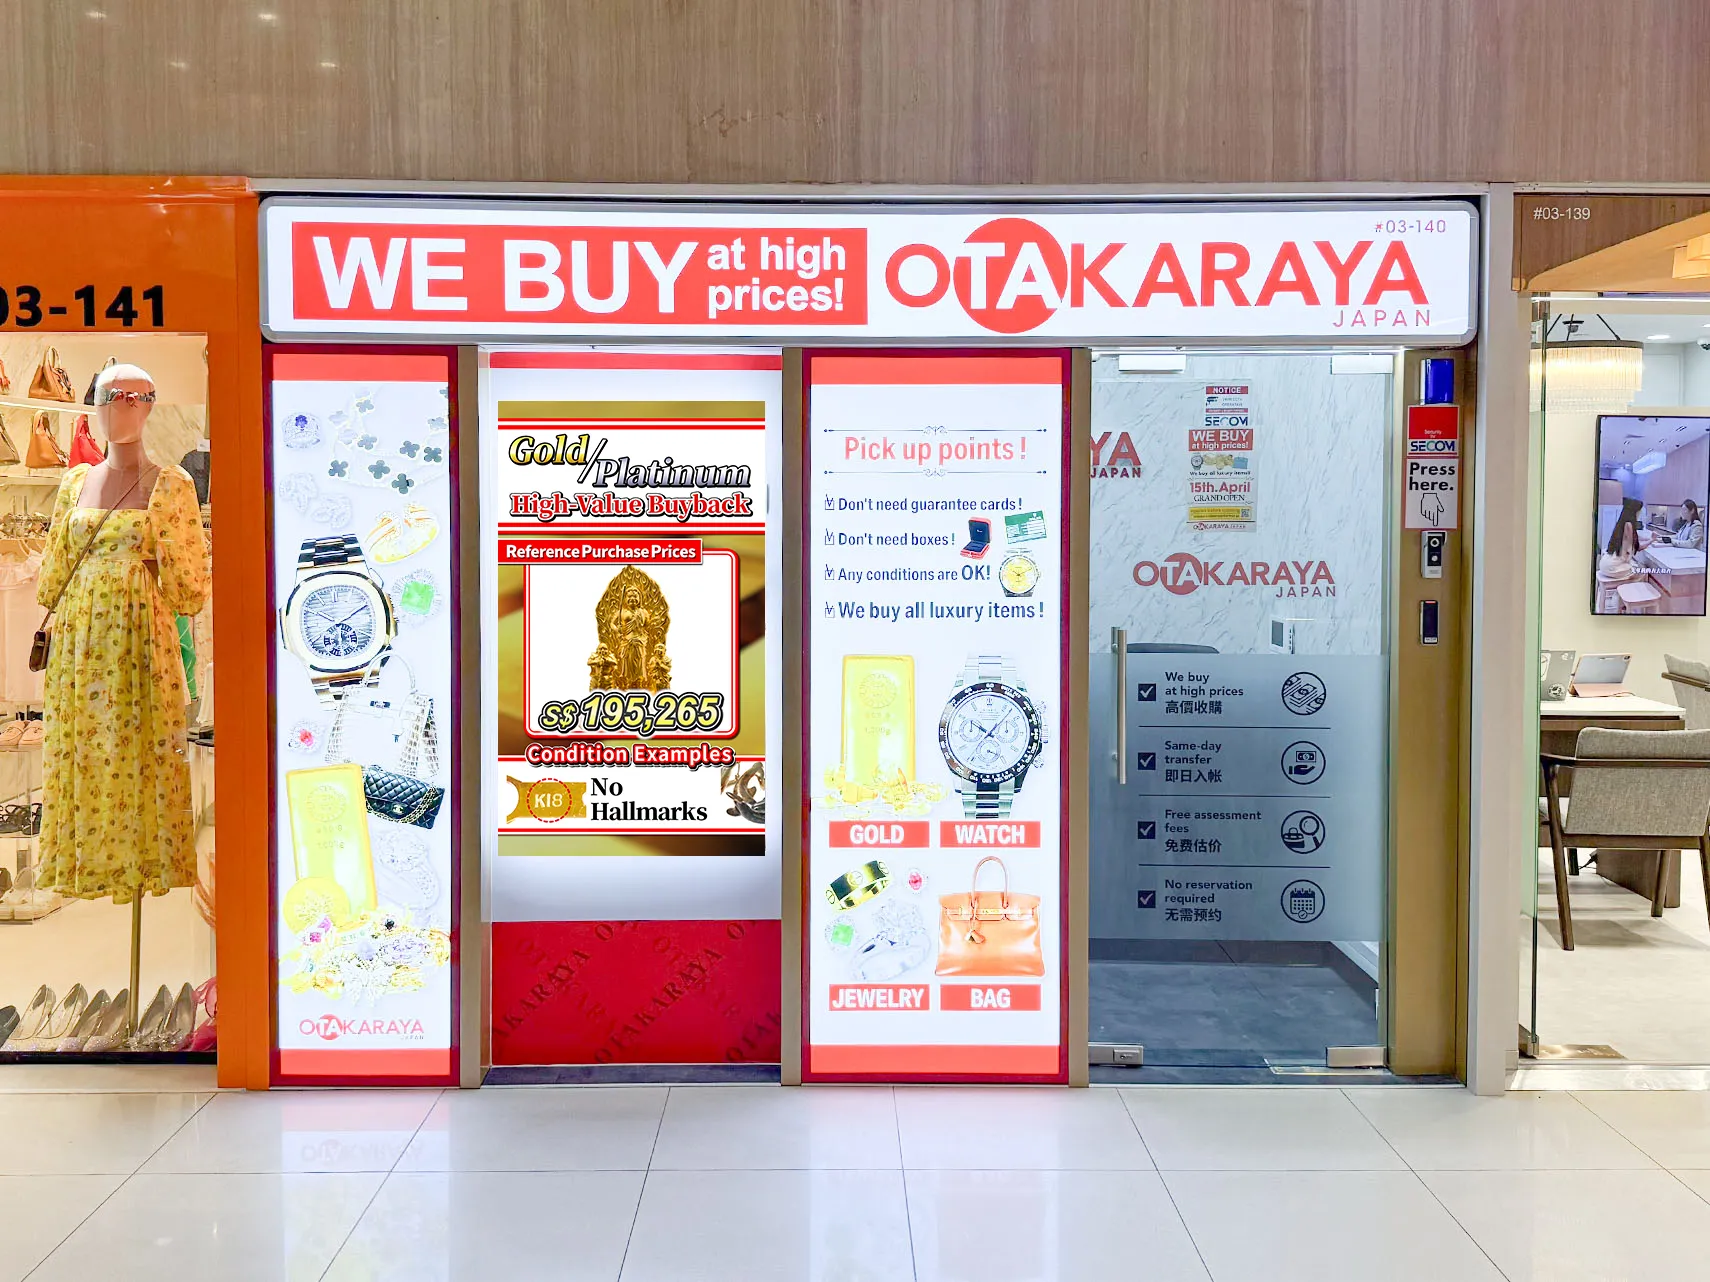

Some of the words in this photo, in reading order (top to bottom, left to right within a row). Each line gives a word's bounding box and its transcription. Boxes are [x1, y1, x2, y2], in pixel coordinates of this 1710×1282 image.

[1533, 206, 1591, 220] #03-139
[1375, 219, 1446, 233] #03-140
[707, 237, 746, 270] at
[759, 237, 846, 279] high
[313, 236, 468, 311] WE
[504, 240, 698, 314] BUY
[885, 238, 1430, 311] OTAKARAYA
[707, 278, 844, 319] prices!
[1333, 309, 1431, 327] JAPAN
[1205, 416, 1248, 426] SECOM
[1192, 431, 1215, 441] WE
[1219, 430, 1249, 441] BUY
[845, 437, 895, 459] Pick
[903, 443, 932, 465] up
[1411, 441, 1455, 451] SECOM
[593, 457, 752, 488] Platinum
[1090, 467, 1141, 478] JAPAN
[1409, 462, 1456, 475] Press
[1409, 476, 1454, 490] here.
[509, 492, 642, 521] High-Value
[645, 492, 751, 521] Buyback
[838, 498, 874, 511] Don't
[876, 498, 908, 511] need
[911, 500, 977, 513] guarantee
[838, 533, 874, 545] Don't
[876, 533, 908, 545] need
[506, 544, 581, 559] Reference
[582, 544, 650, 559] Purchase
[651, 544, 697, 559] Prices
[838, 568, 862, 583] Any
[866, 568, 934, 580] conditions
[937, 570, 958, 581] are
[961, 565, 991, 580] OK!
[1133, 560, 1335, 587] OTAKARAYA
[1276, 586, 1336, 598] JAPAN
[838, 602, 865, 618] We
[869, 602, 900, 622] buy
[905, 602, 925, 618] all
[930, 602, 984, 622] luxury
[1165, 672, 1184, 682] We
[1188, 672, 1209, 684] buy
[1165, 687, 1177, 696] at
[1180, 686, 1206, 698] high
[1209, 686, 1244, 699] prices
[1165, 700, 1222, 714] 高價收購
[1165, 741, 1222, 753] Same-day
[527, 745, 628, 763] Condition
[634, 745, 732, 768] Examples
[1165, 755, 1212, 765] transfer
[591, 778, 623, 796] No
[591, 801, 708, 821] Hallmarks
[1165, 810, 1191, 820] Free
[1194, 810, 1262, 821] assessment
[850, 825, 904, 844] GOLD
[955, 825, 1025, 844] WATCH
[1165, 824, 1189, 834] fees
[1165, 839, 1222, 853] 免费估价
[1165, 879, 1182, 890] No
[1185, 880, 1253, 890] reservation
[1165, 893, 1215, 905] required
[1165, 908, 1222, 922] 无需预约
[832, 989, 924, 1008] JEWELRY
[971, 989, 1011, 1008] BAG
[299, 1019, 425, 1035] OTAKARAYA
